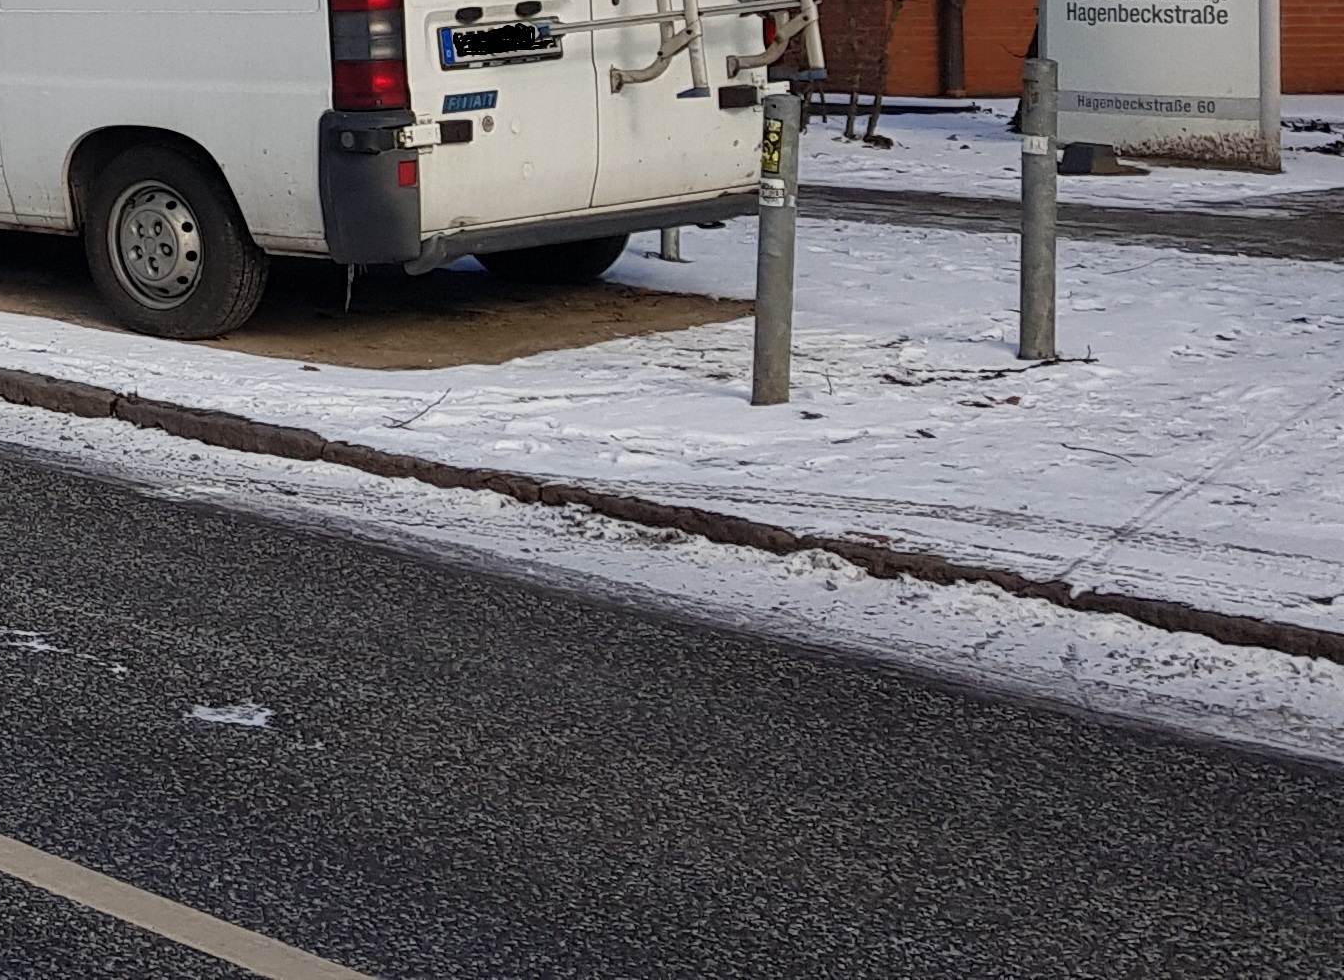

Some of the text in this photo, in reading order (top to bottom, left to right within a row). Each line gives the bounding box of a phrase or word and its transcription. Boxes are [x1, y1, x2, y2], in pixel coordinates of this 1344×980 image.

[1066, 1, 1229, 26] Hagenbeckstraße
[447, 92, 495, 111] FIAT
[1077, 93, 1216, 114] Hagenbeckstraße 60
